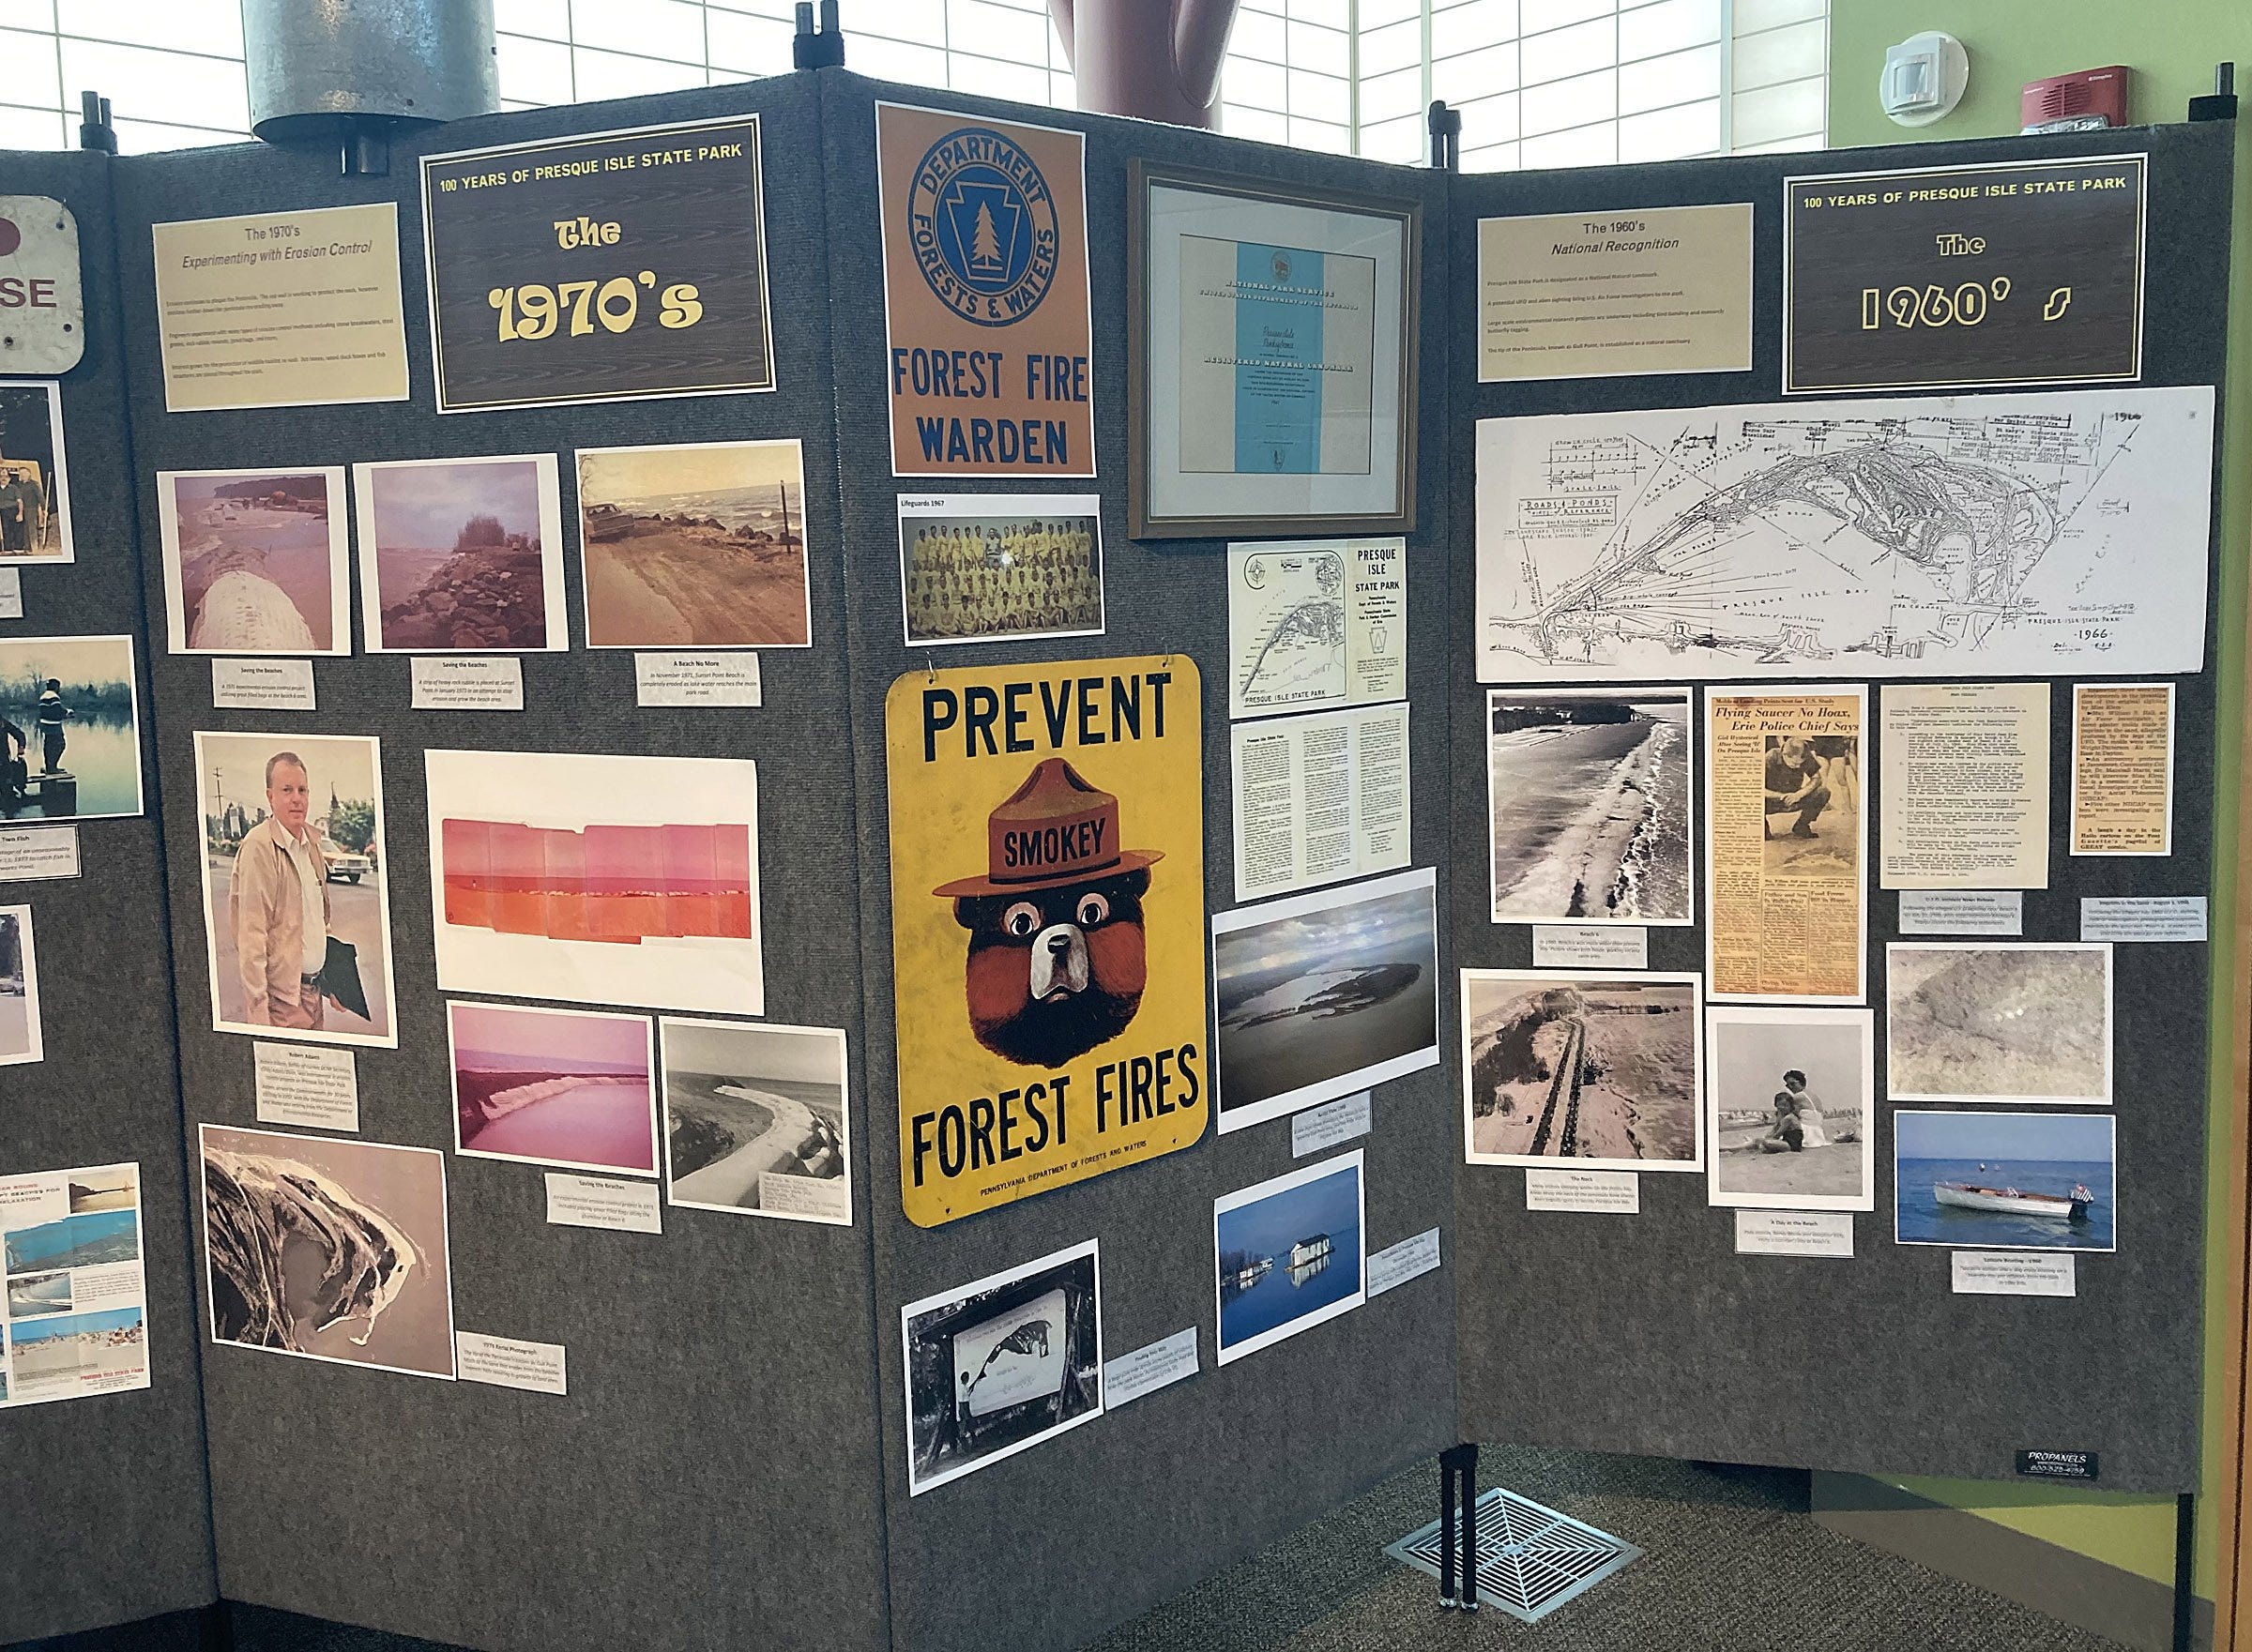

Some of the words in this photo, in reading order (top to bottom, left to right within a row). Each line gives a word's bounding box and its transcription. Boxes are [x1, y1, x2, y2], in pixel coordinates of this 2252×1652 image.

[440, 180, 457, 192] 100
[462, 173, 507, 190] YEARS
[512, 171, 529, 183] OF
[536, 159, 599, 180] PRESQUE
[605, 156, 635, 171] ISLE
[642, 149, 692, 167] STATE
[698, 144, 743, 160] PARK
[919, 135, 1047, 205] DEPARTMENT
[1803, 197, 1822, 209] 100
[1829, 193, 1878, 207] YEARS
[1883, 192, 1902, 204] OF
[1910, 188, 1979, 203] PRESQUE
[1986, 184, 2017, 197] ISLE
[2024, 180, 2076, 194] STATE
[2082, 176, 2126, 190] PARK
[245, 228, 266, 241] The
[269, 226, 300, 238] 1970's
[554, 217, 621, 250] The
[1583, 222, 1606, 235] The
[1610, 220, 1645, 233] 1960's
[183, 252, 257, 270] Experimenting
[260, 248, 282, 262] with
[329, 240, 373, 256] Control
[1551, 241, 1603, 255] National
[1605, 238, 1680, 252] Recognition
[1936, 233, 1986, 256] The
[915, 214, 978, 314] FORESTS
[1004, 228, 1054, 315] WATERS
[1272, 283, 1295, 293] PARK
[488, 270, 704, 342] 1970's
[892, 348, 1003, 399] FOREST
[1027, 355, 1088, 402] FIRE
[1264, 360, 1304, 370] NATURAL
[916, 417, 1068, 464] WARDEN
[1358, 549, 1396, 561] PRESQUE
[1368, 564, 1386, 575] ISLE
[1356, 583, 1377, 592] STATE
[1380, 582, 1400, 590] PARK
[2079, 629, 2107, 640] 1966
[922, 673, 1172, 763] PREVENT
[1715, 707, 1751, 720] Flying
[1756, 708, 1794, 718] Saucer
[1799, 708, 1814, 718] No
[1818, 707, 1850, 719] Hoax,
[1732, 721, 1756, 731] Erie
[1759, 721, 1795, 731] Police
[1799, 720, 1831, 733] Chief
[1834, 721, 1859, 734] Says
[1004, 818, 1106, 868] SMOKEY
[912, 1075, 1071, 1187] FOREST
[1095, 1043, 1199, 1133] FIRES
[981, 1176, 1026, 1197] PENNSYLVANIA
[1028, 1164, 1068, 1182] DEPARTMENT
[1072, 1160, 1078, 1169] OF
[1081, 1152, 1107, 1165] FORESTS
[1110, 1148, 1121, 1157] AND
[1124, 1141, 1147, 1152] WATERS
[2029, 1451, 2087, 1463] PROPANELS
